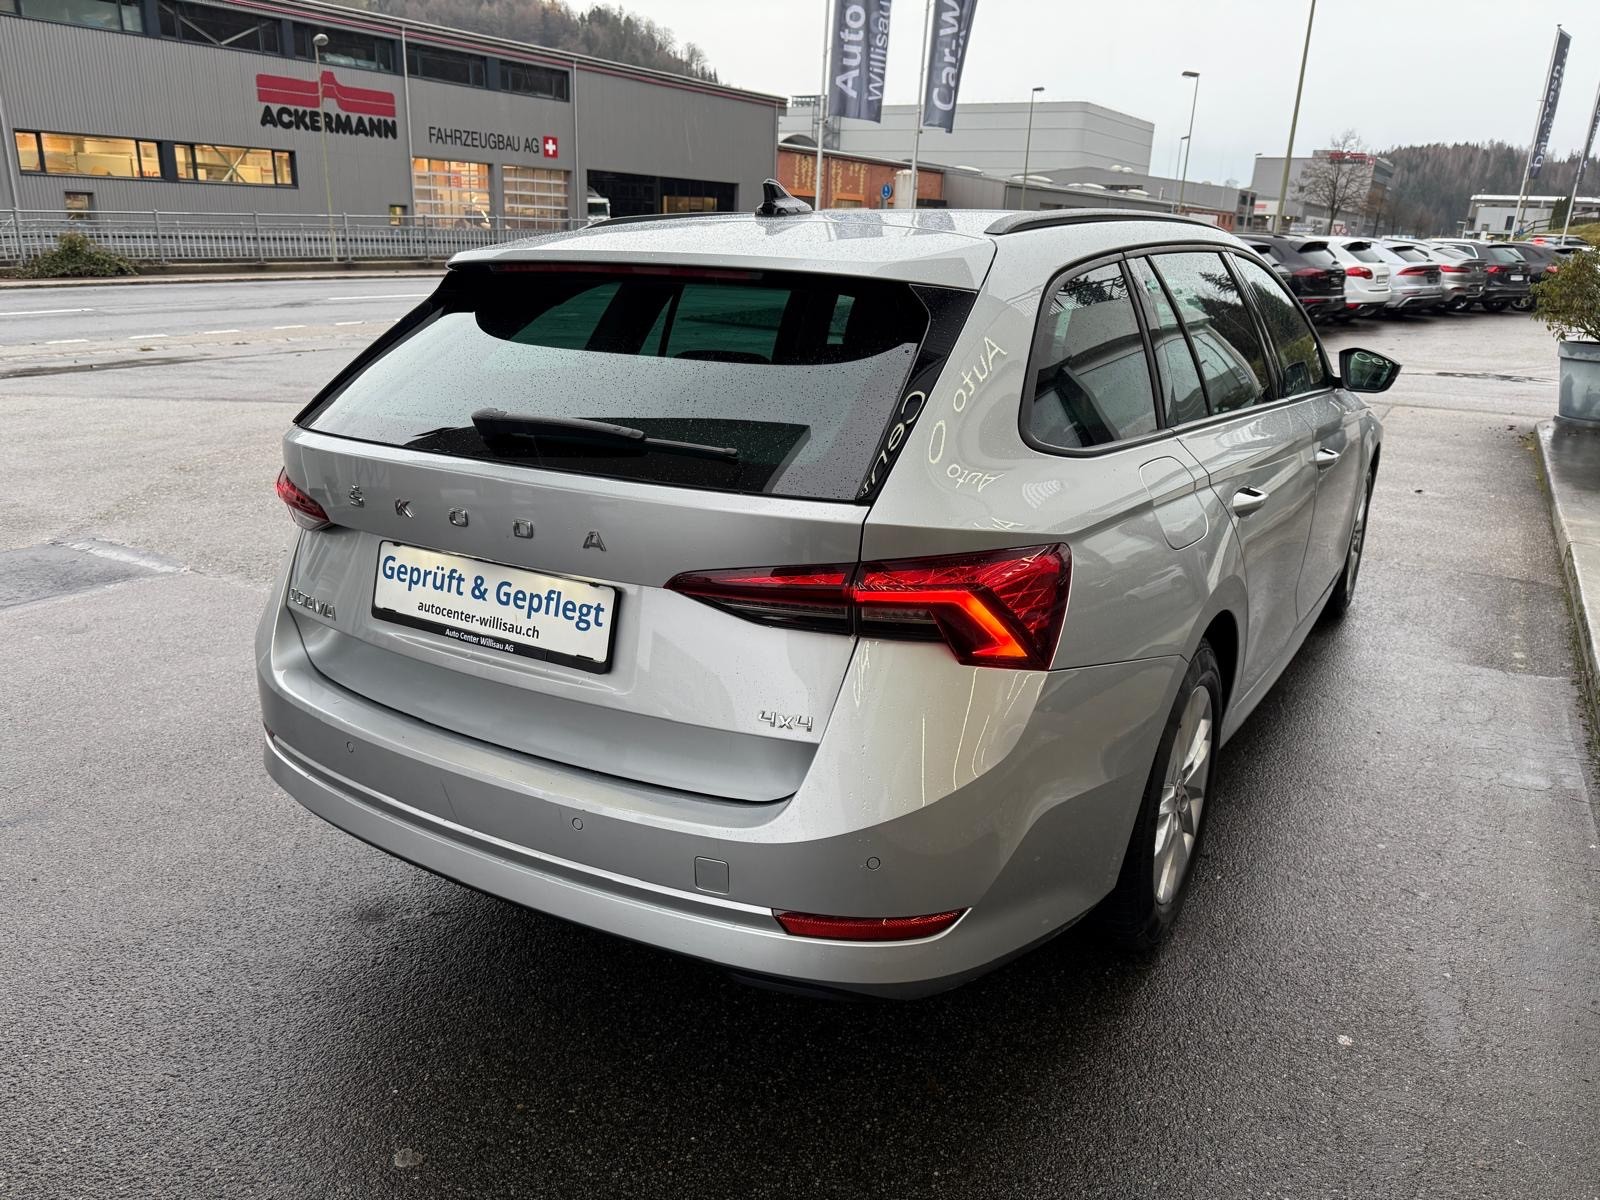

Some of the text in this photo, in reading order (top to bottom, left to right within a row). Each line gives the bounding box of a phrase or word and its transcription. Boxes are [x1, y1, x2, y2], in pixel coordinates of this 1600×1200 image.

[835, 4, 866, 99] Auto
[260, 105, 397, 139] ACKERMANN
[428, 126, 540, 154] FAHRZEUGBAU AG
[382, 555, 606, 632] Geprüft & Gepflegt
[417, 601, 541, 640] autocenter-willisau.ch
[444, 628, 515, 653] Auto Center Willisau AG
[758, 710, 814, 732] 4x4
